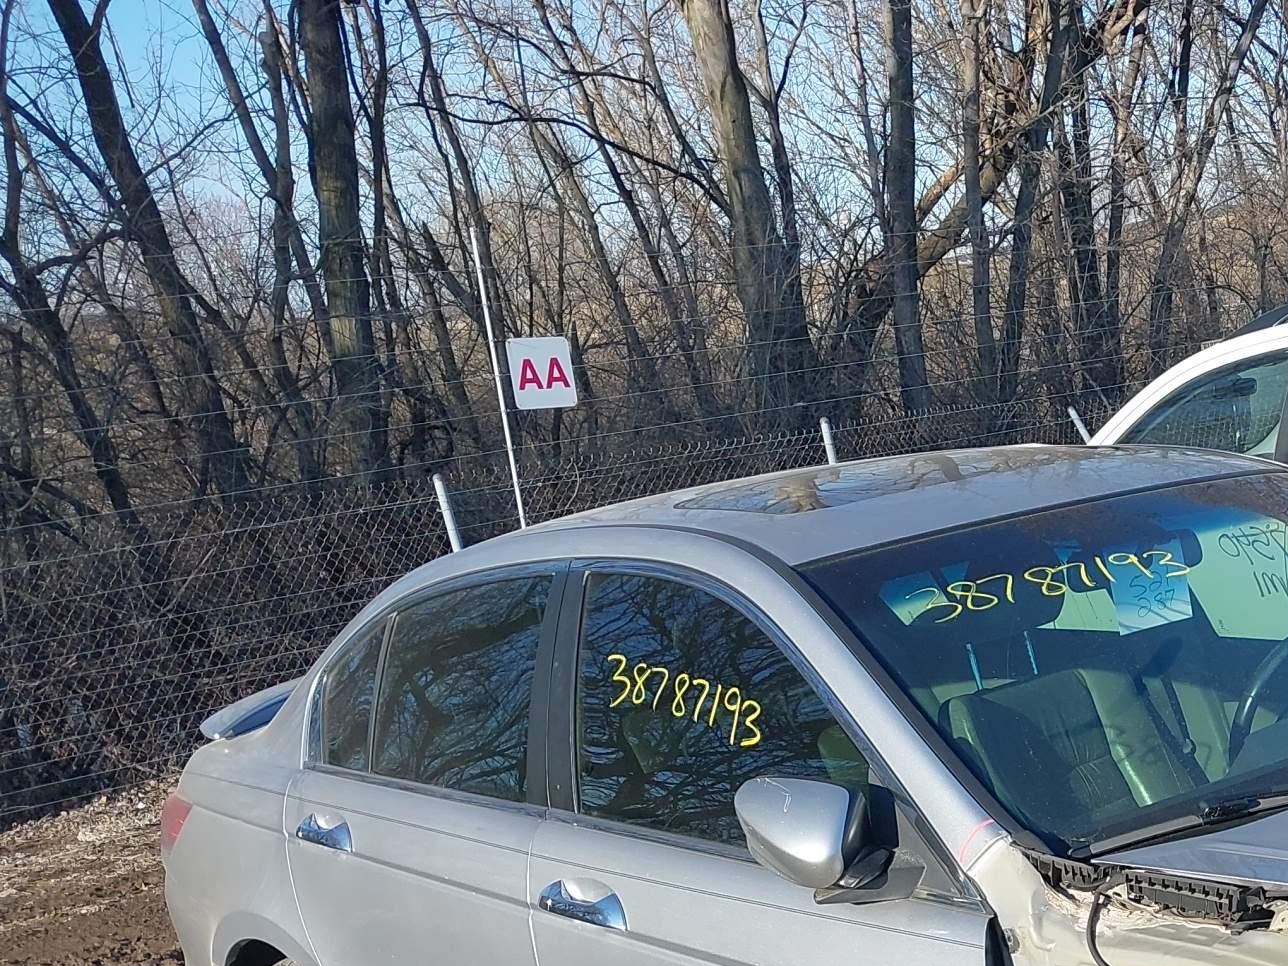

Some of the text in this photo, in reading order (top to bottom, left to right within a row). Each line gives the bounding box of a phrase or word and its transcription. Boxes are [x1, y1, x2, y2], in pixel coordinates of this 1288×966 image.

[518, 357, 572, 391] AA
[905, 550, 1191, 624] 38787193
[607, 654, 762, 747] 38787193
